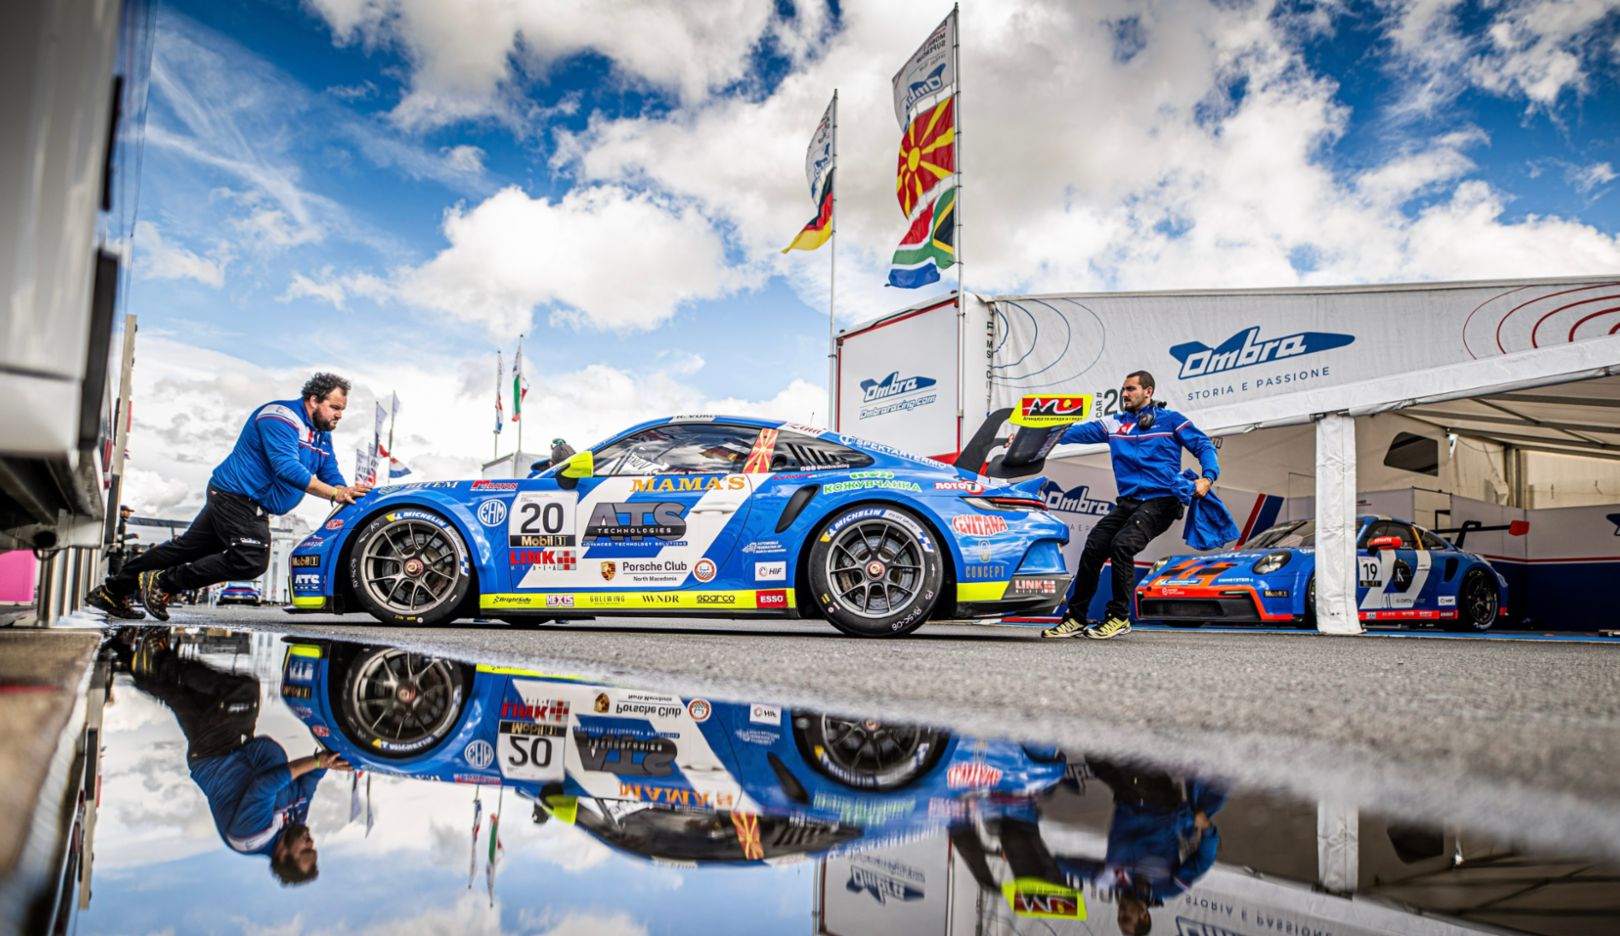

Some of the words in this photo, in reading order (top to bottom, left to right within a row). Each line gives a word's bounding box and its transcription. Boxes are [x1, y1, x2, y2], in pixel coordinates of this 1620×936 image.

[1178, 326, 1307, 380] Ombra
[863, 371, 918, 403] Ombra
[1187, 385, 1235, 401] STORIA
[1241, 381, 1249, 391] E
[1256, 366, 1331, 389] PASSIONE
[1095, 400, 1104, 418] CAR
[629, 476, 746, 492] MAMA'S
[1045, 487, 1111, 515] Ombra
[403, 511, 446, 526] MICHELIN
[520, 502, 564, 534] 20
[582, 502, 687, 542] ATS
[834, 508, 882, 531] MICHELIN
[521, 535, 553, 546] Mobil
[510, 551, 556, 564] LINK
[622, 562, 662, 572] Porsche
[664, 561, 687, 571] Club
[768, 567, 782, 575] HIF
[966, 565, 1005, 578] CONCEPT
[1363, 562, 1377, 580] 19
[1015, 580, 1043, 589] LINK
[696, 595, 736, 604] sparco
